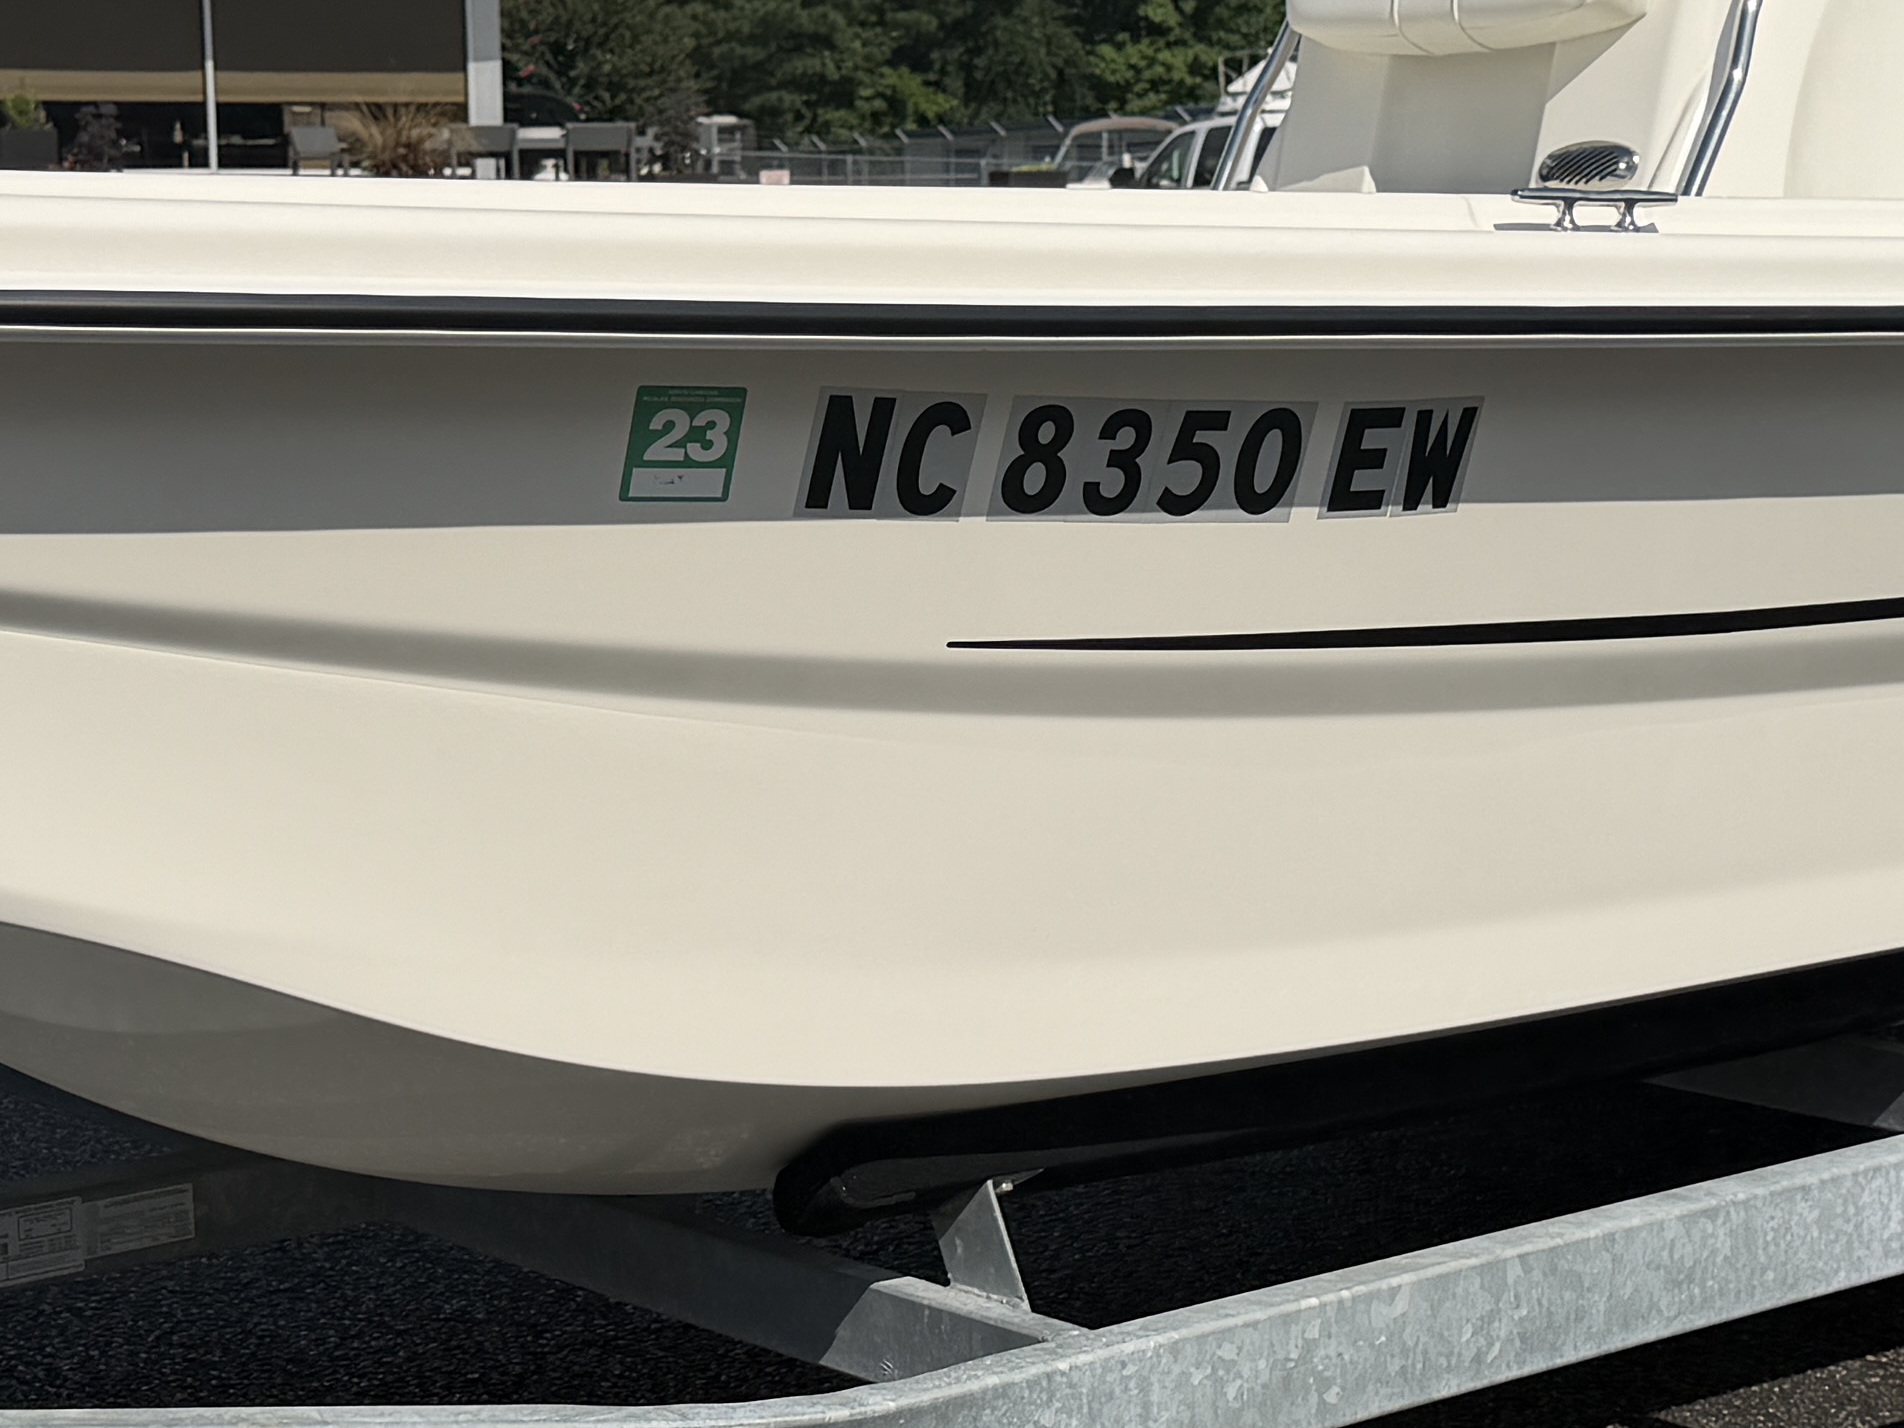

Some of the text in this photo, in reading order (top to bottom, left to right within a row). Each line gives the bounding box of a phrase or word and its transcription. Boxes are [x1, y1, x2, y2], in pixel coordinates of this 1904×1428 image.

[642, 408, 731, 462] 23
[804, 395, 1479, 516] NC 8350 EW
